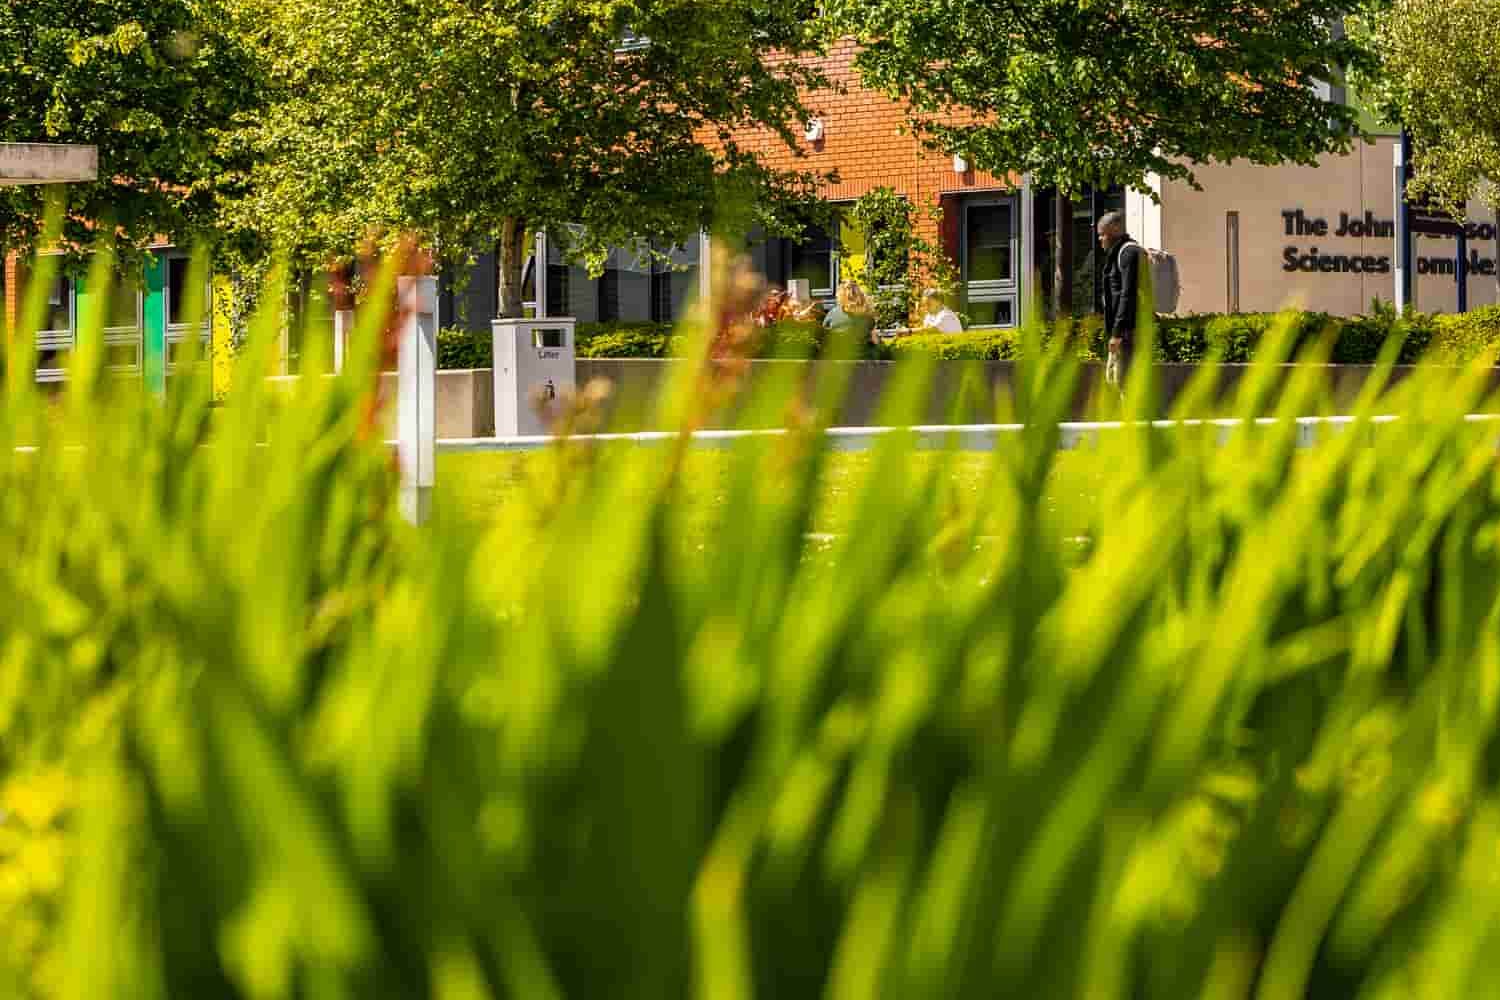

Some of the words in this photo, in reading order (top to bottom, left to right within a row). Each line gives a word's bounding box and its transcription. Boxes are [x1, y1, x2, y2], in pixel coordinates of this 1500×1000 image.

[1282, 209, 1328, 237] The
[1335, 209, 1395, 238] John
[1282, 246, 1390, 273] Sciences
